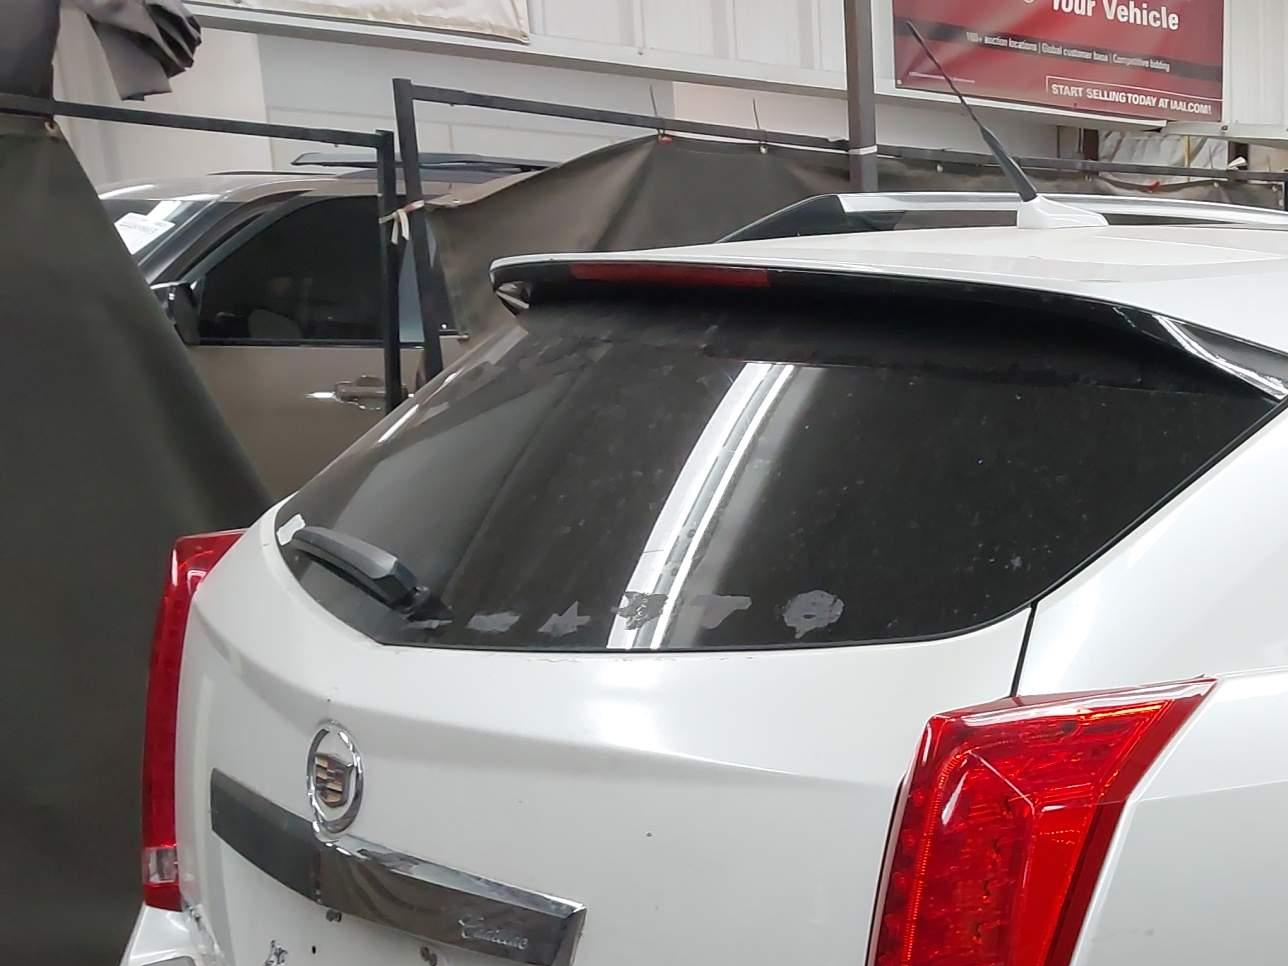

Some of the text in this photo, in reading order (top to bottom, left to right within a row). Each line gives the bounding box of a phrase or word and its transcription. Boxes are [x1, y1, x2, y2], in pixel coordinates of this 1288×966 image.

[1102, 0, 1179, 30] Vehicle
[1051, 83, 1083, 99] START
[1086, 88, 1126, 104] SELLING
[1126, 94, 1157, 107] TODAY
[1158, 98, 1169, 108] AT
